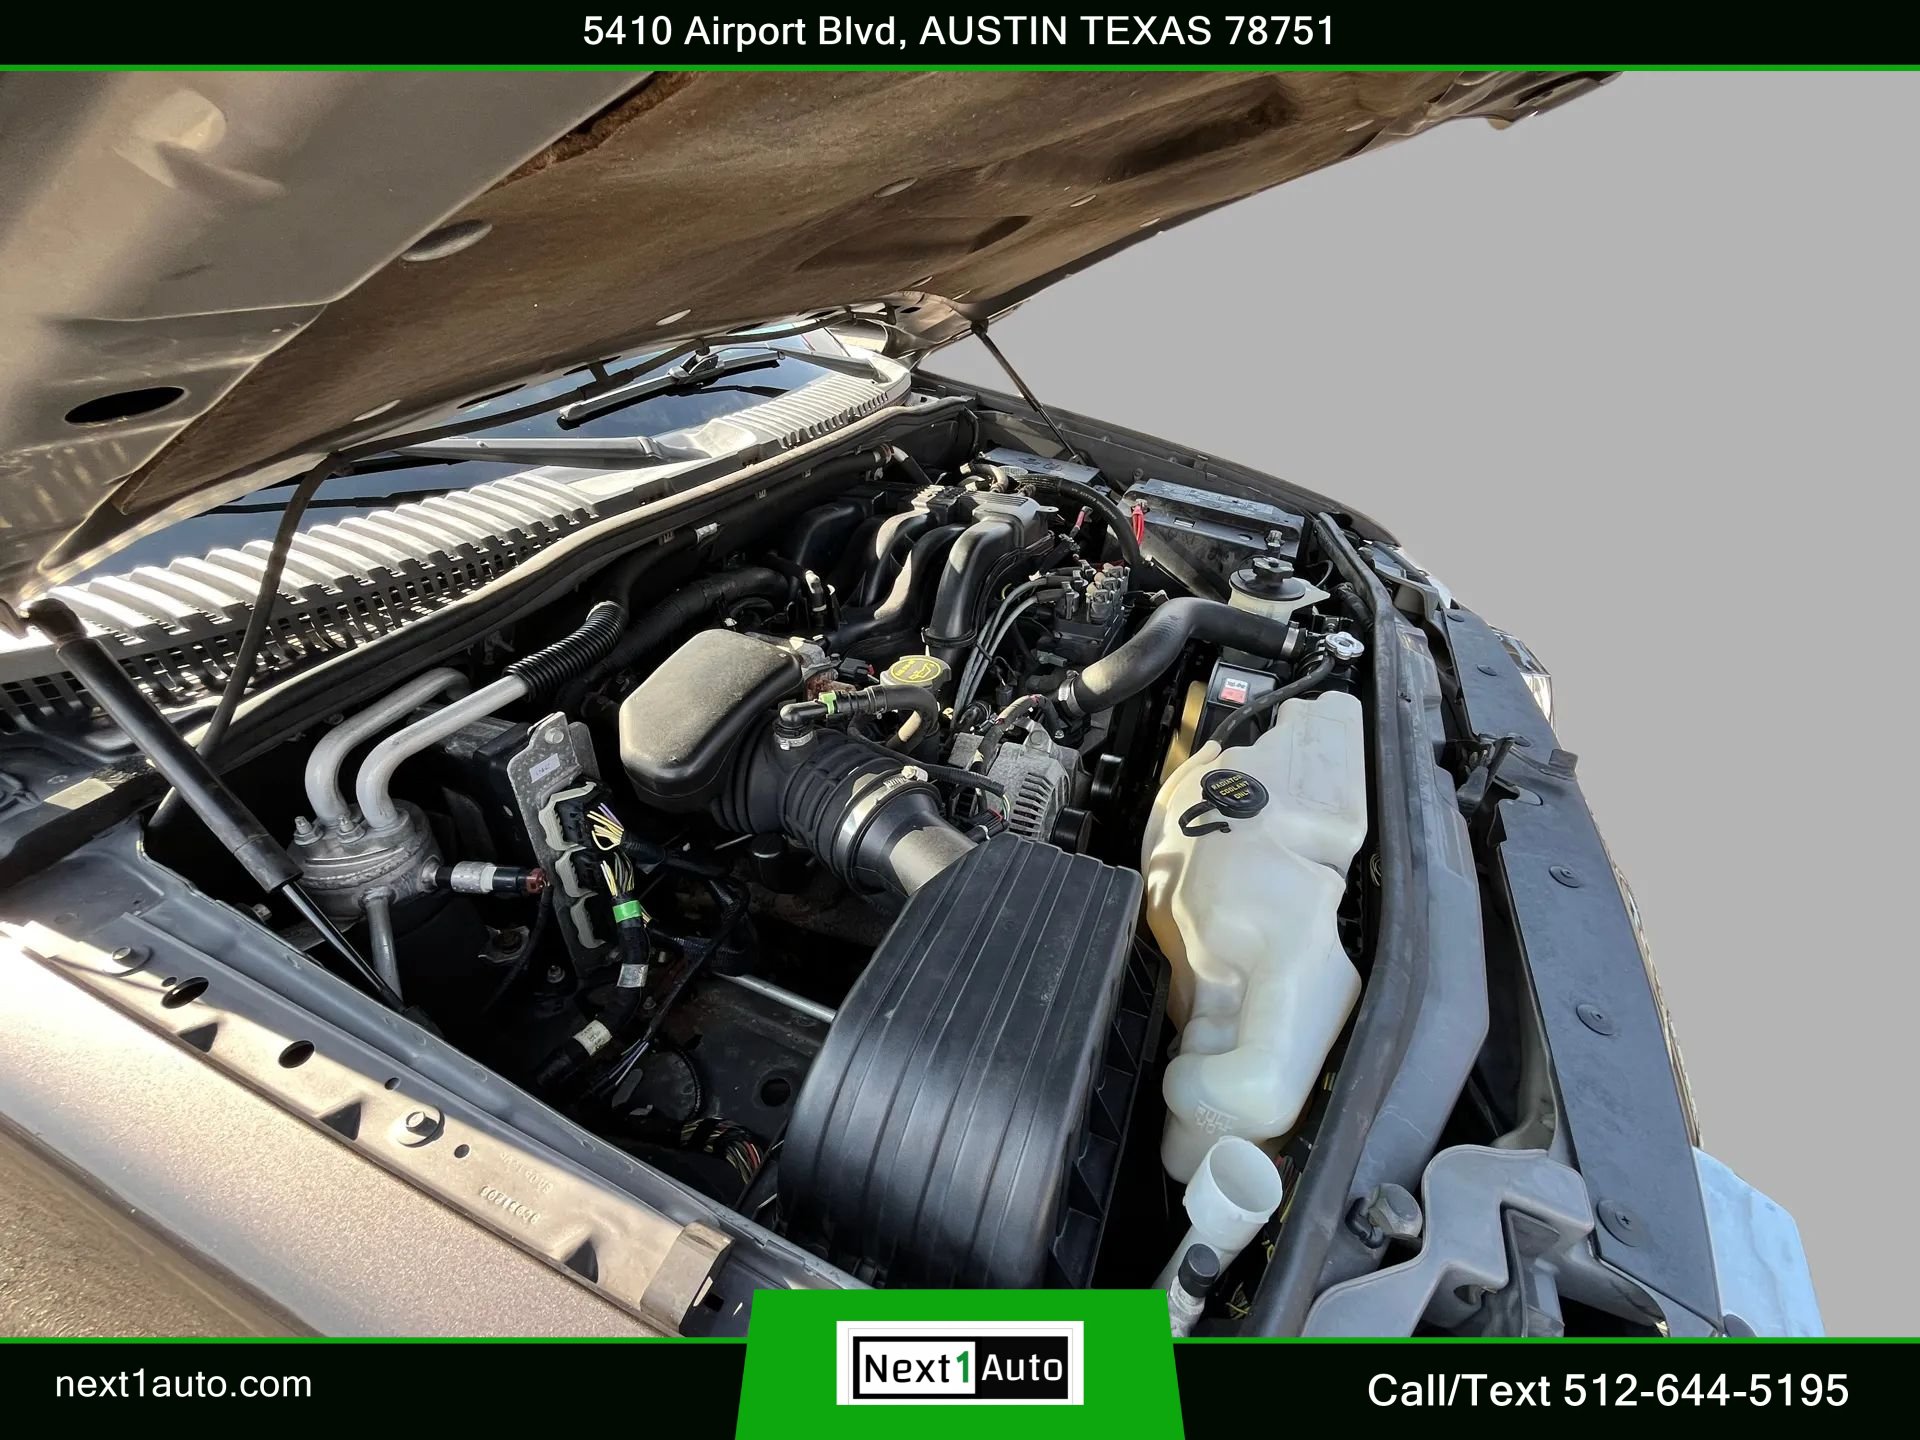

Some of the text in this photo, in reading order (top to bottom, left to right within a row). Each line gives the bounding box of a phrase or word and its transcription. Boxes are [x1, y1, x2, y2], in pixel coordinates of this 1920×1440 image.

[1211, 775, 1242, 790] RADIATOR
[1219, 780, 1250, 796] COOLANT
[1233, 789, 1250, 799] ONLY
